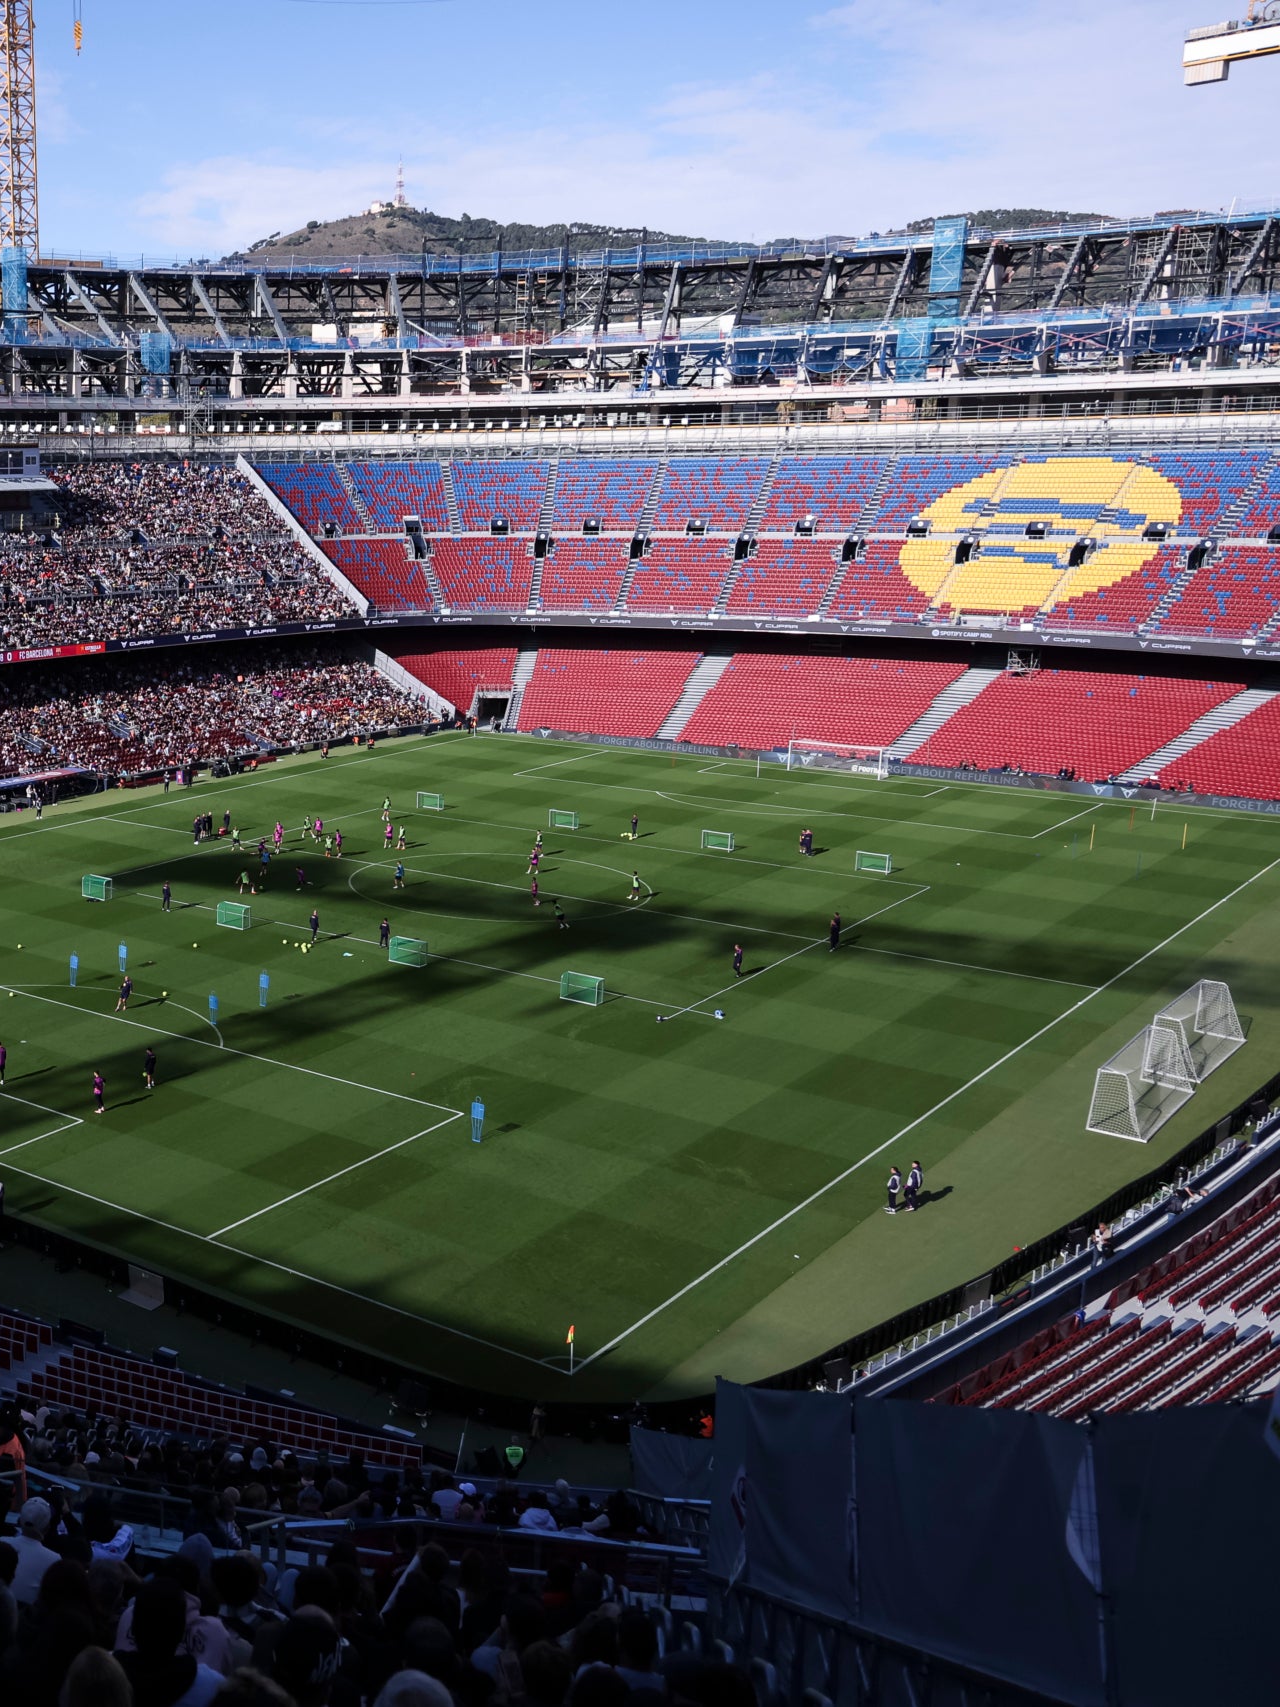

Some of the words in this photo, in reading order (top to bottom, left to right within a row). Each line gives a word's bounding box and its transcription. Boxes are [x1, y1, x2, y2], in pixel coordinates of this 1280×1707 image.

[129, 639, 155, 647] CUPRA
[192, 633, 216, 641] CUPRA
[1151, 642, 1191, 650] CUPRA
[7, 652, 12, 662] 0
[19, 650, 25, 660] FC
[26, 648, 54, 659] BARCELONA
[599, 736, 632, 746] FORGET
[634, 740, 666, 750] ABOUT
[666, 742, 719, 756] REFUELLING
[914, 768, 952, 780] ABOUT
[954, 770, 1020, 786] REFUELLING
[1211, 797, 1264, 811] FORGET
